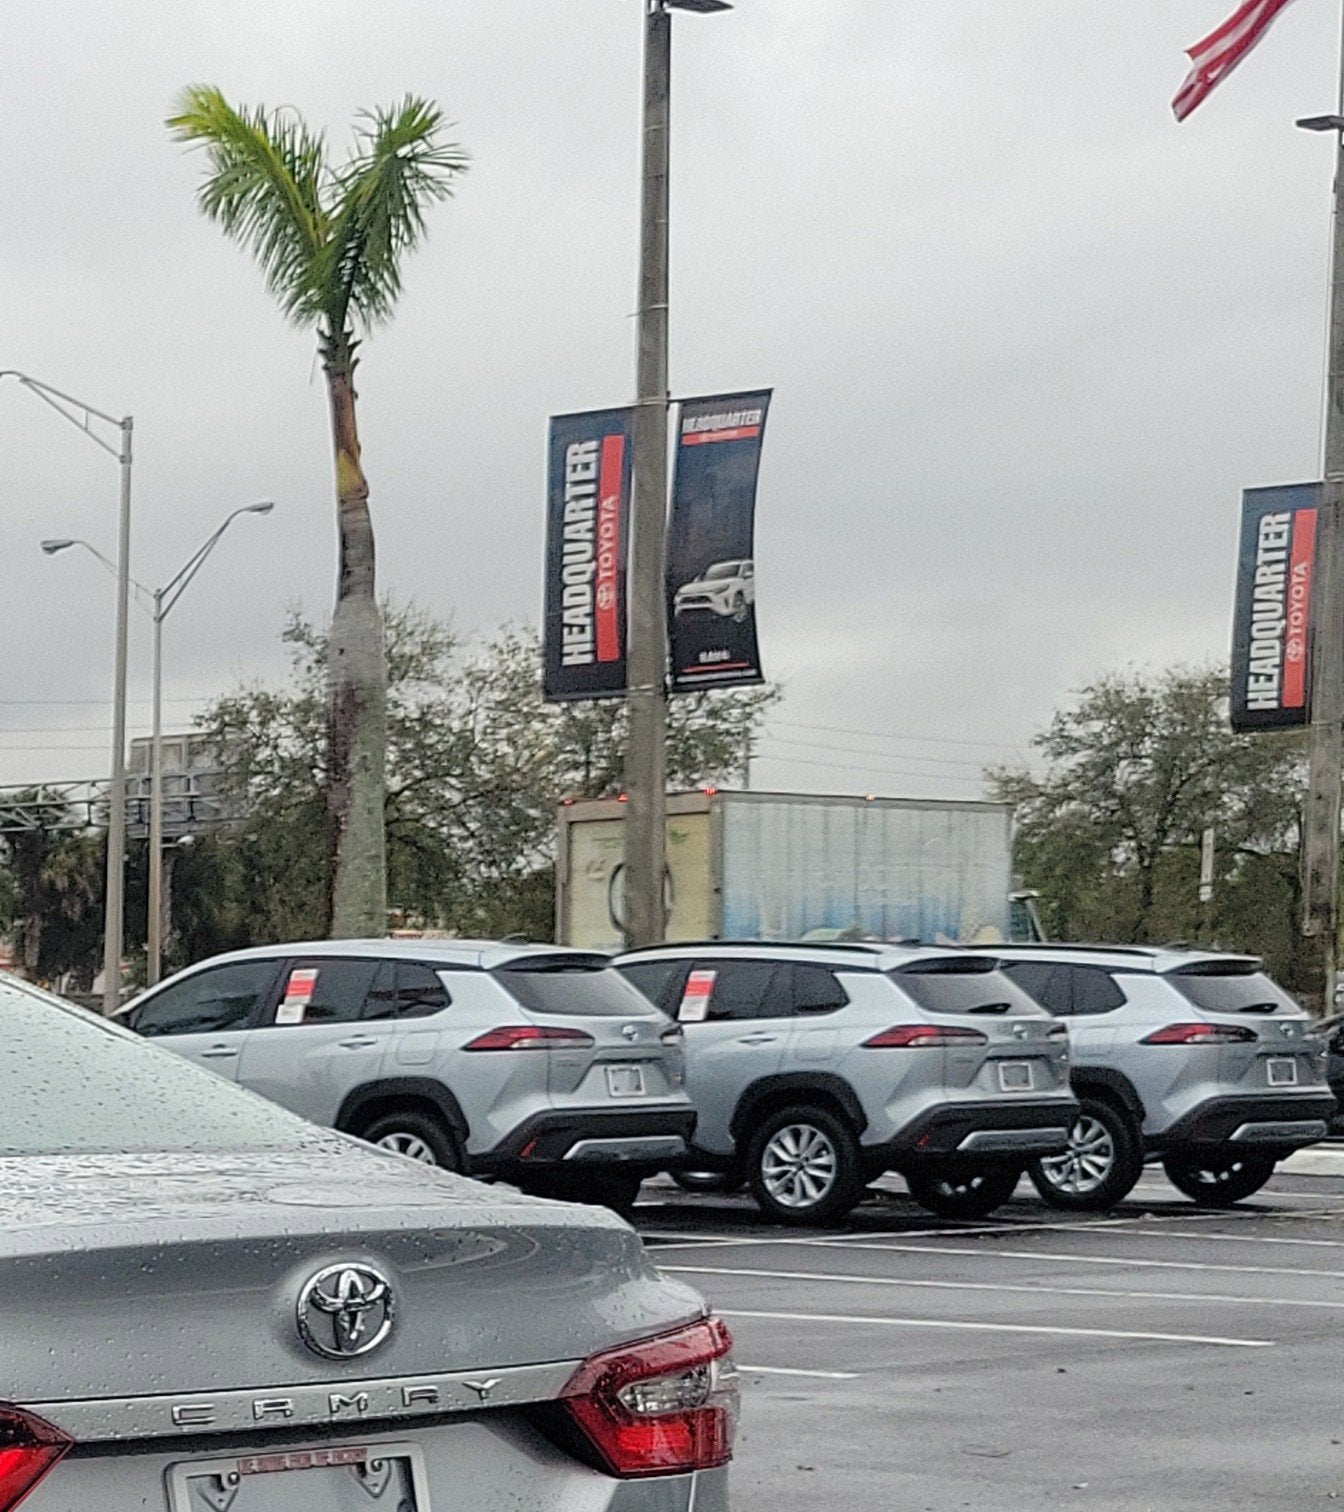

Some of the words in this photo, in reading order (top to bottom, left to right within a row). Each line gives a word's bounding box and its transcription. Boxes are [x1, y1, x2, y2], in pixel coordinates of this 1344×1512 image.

[561, 440, 600, 667] HEADQUARTER
[598, 495, 619, 581] TOYOTA
[1246, 511, 1292, 711] HEADQUARTER
[1289, 561, 1310, 634] TOYOTA
[171, 1377, 503, 1427] CAMRY
